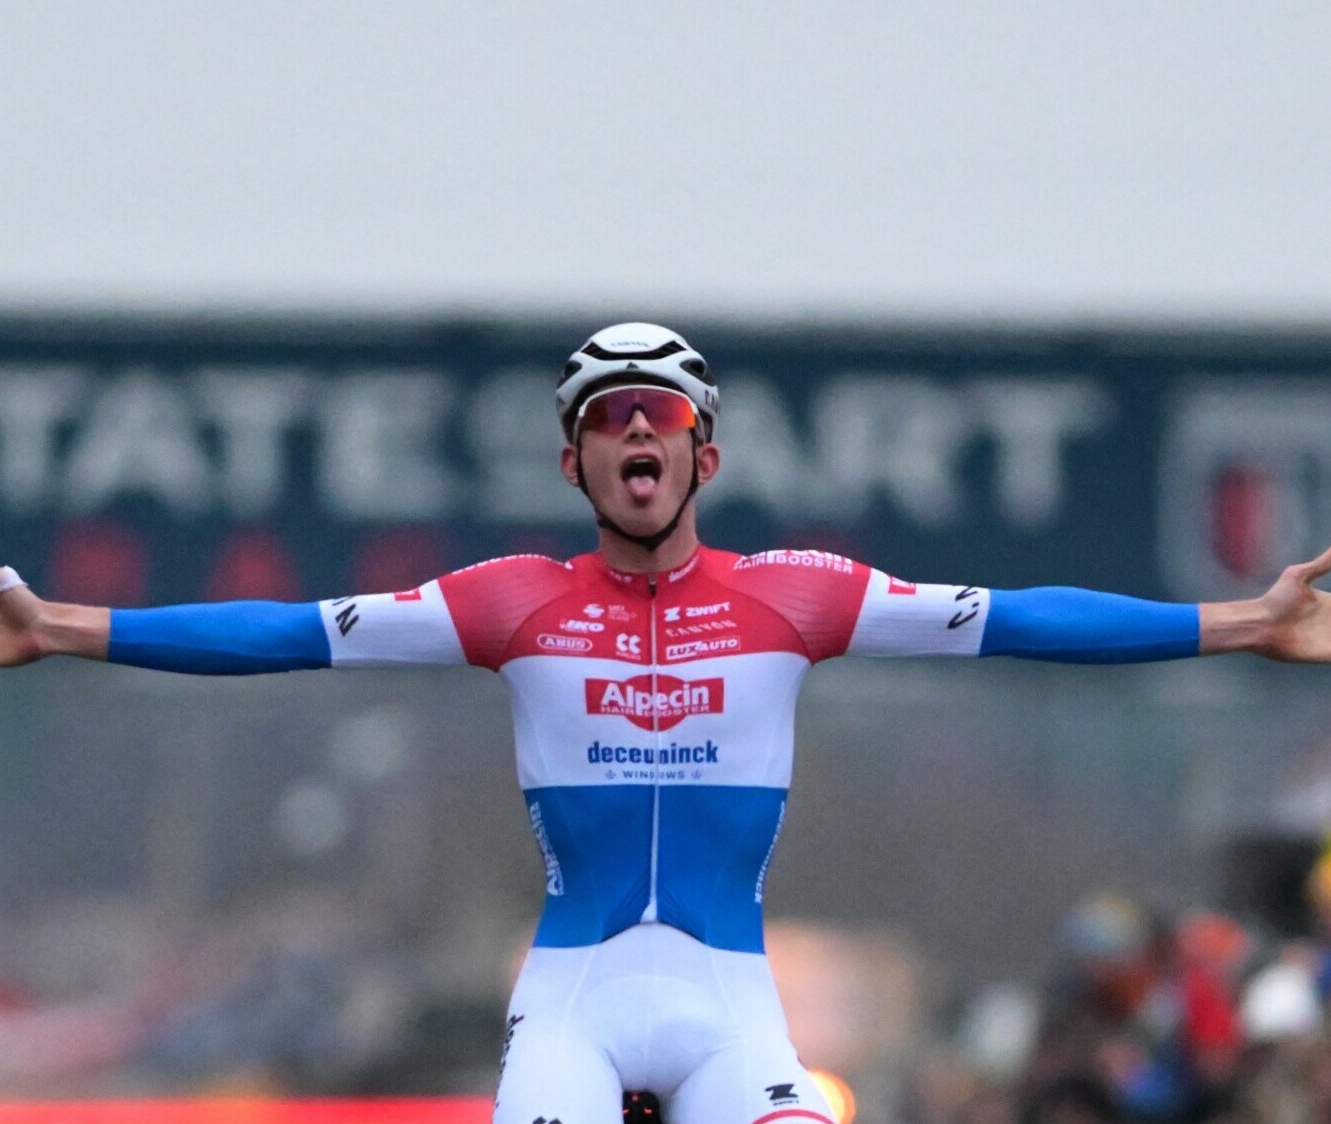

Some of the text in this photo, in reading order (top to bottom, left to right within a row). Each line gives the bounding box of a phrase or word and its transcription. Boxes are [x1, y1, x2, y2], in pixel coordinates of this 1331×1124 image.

[686, 602, 731, 617] ZWIFT
[545, 636, 586, 649] ABUS
[600, 682, 710, 715] Alpecin
[587, 740, 719, 764] deceuninck
